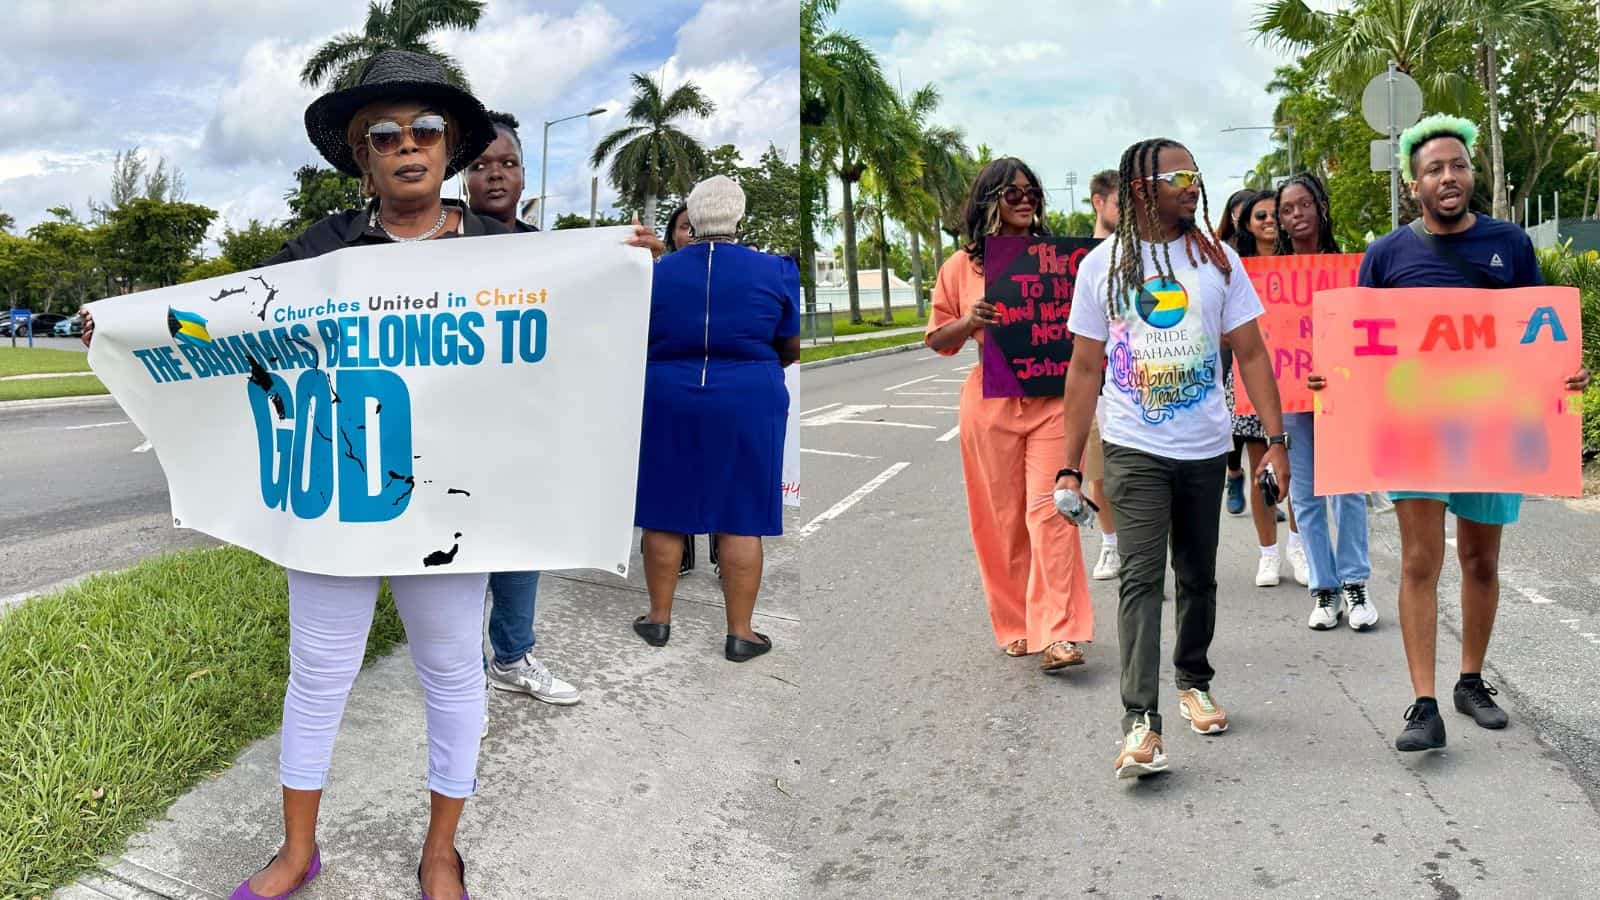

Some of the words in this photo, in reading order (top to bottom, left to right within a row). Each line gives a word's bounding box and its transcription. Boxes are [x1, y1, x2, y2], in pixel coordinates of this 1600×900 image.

[274, 298, 361, 323] Churches
[368, 291, 439, 311] United
[447, 292, 467, 308] in
[475, 288, 548, 307] Christ
[132, 345, 193, 384] THE
[177, 322, 319, 379] BAHAMAS
[317, 310, 486, 369] BELONGS
[495, 307, 548, 365] TO
[1133, 343, 1202, 361] BAHAMAS
[1145, 328, 1189, 345] PRIDE
[1352, 318, 1399, 357] I
[1418, 313, 1498, 353] AM
[1519, 305, 1569, 345] A
[247, 368, 414, 523] GOD
